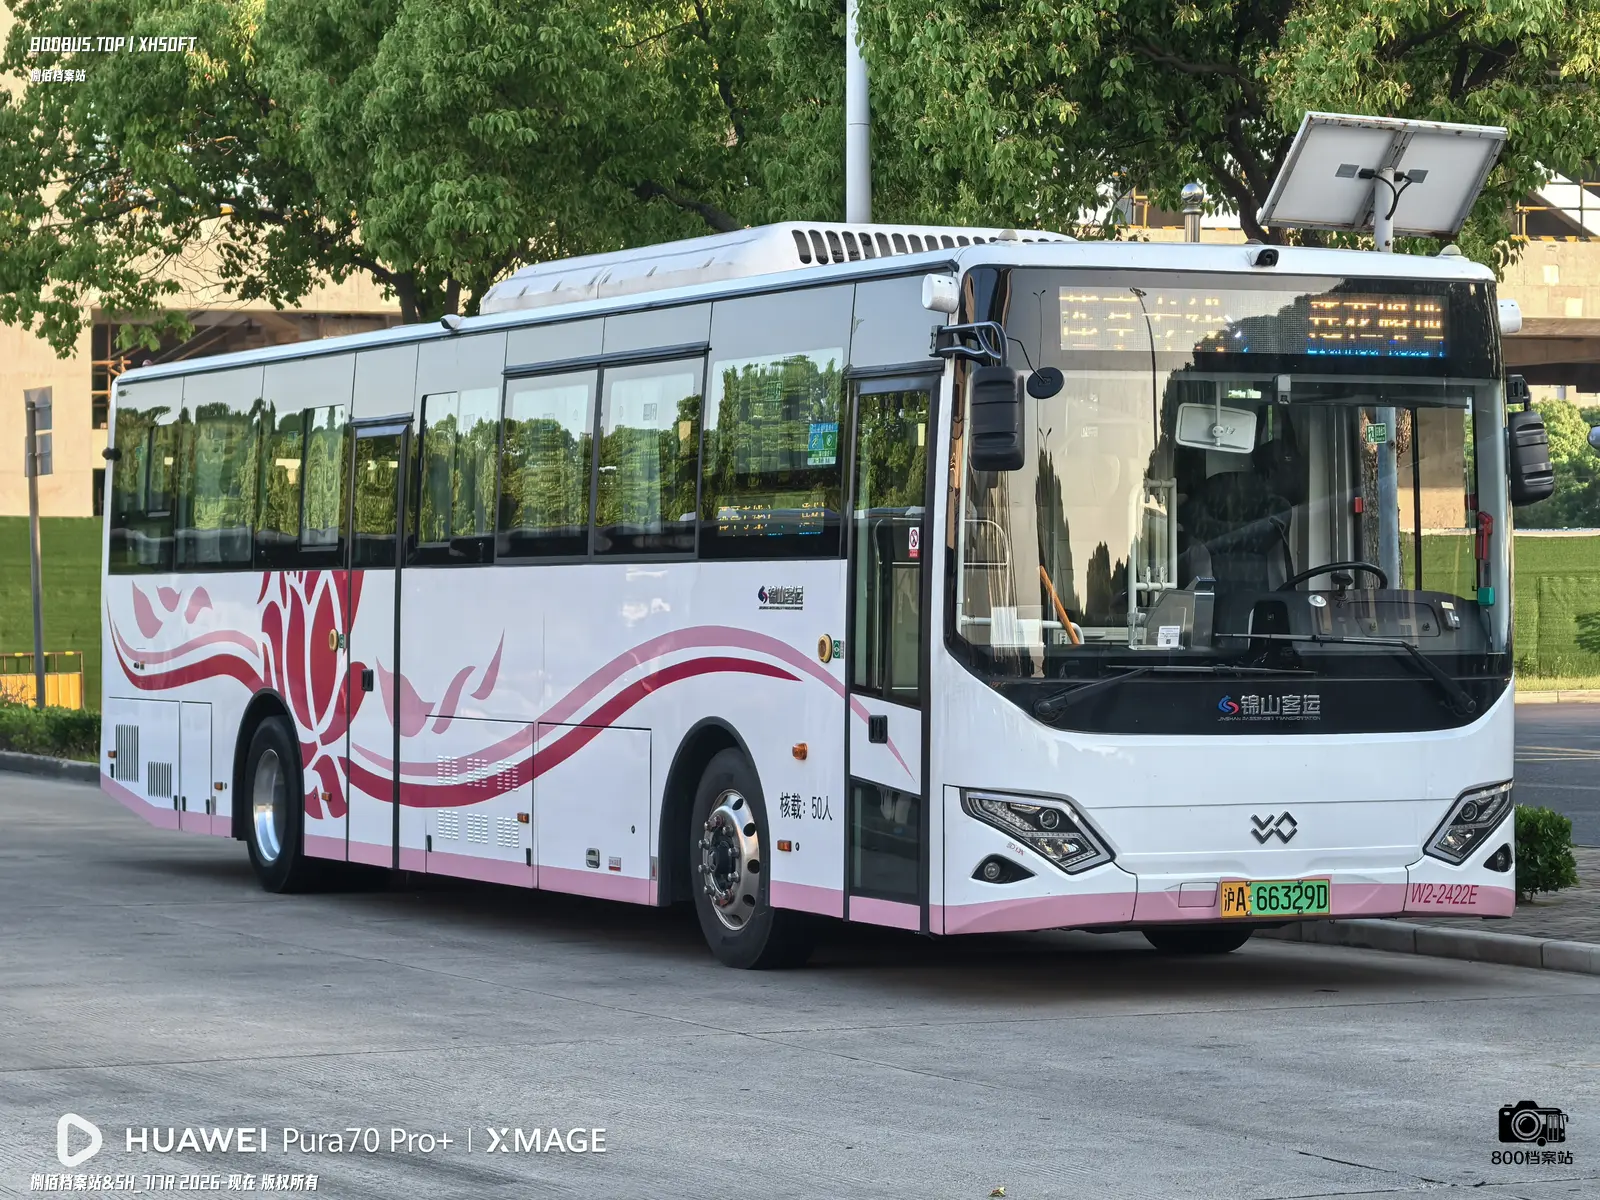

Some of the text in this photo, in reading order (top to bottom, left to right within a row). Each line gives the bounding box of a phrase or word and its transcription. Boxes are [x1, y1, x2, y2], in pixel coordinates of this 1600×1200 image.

[1240, 694, 1321, 715] 锦山客运
[1411, 882, 1480, 905] W2-2422E
